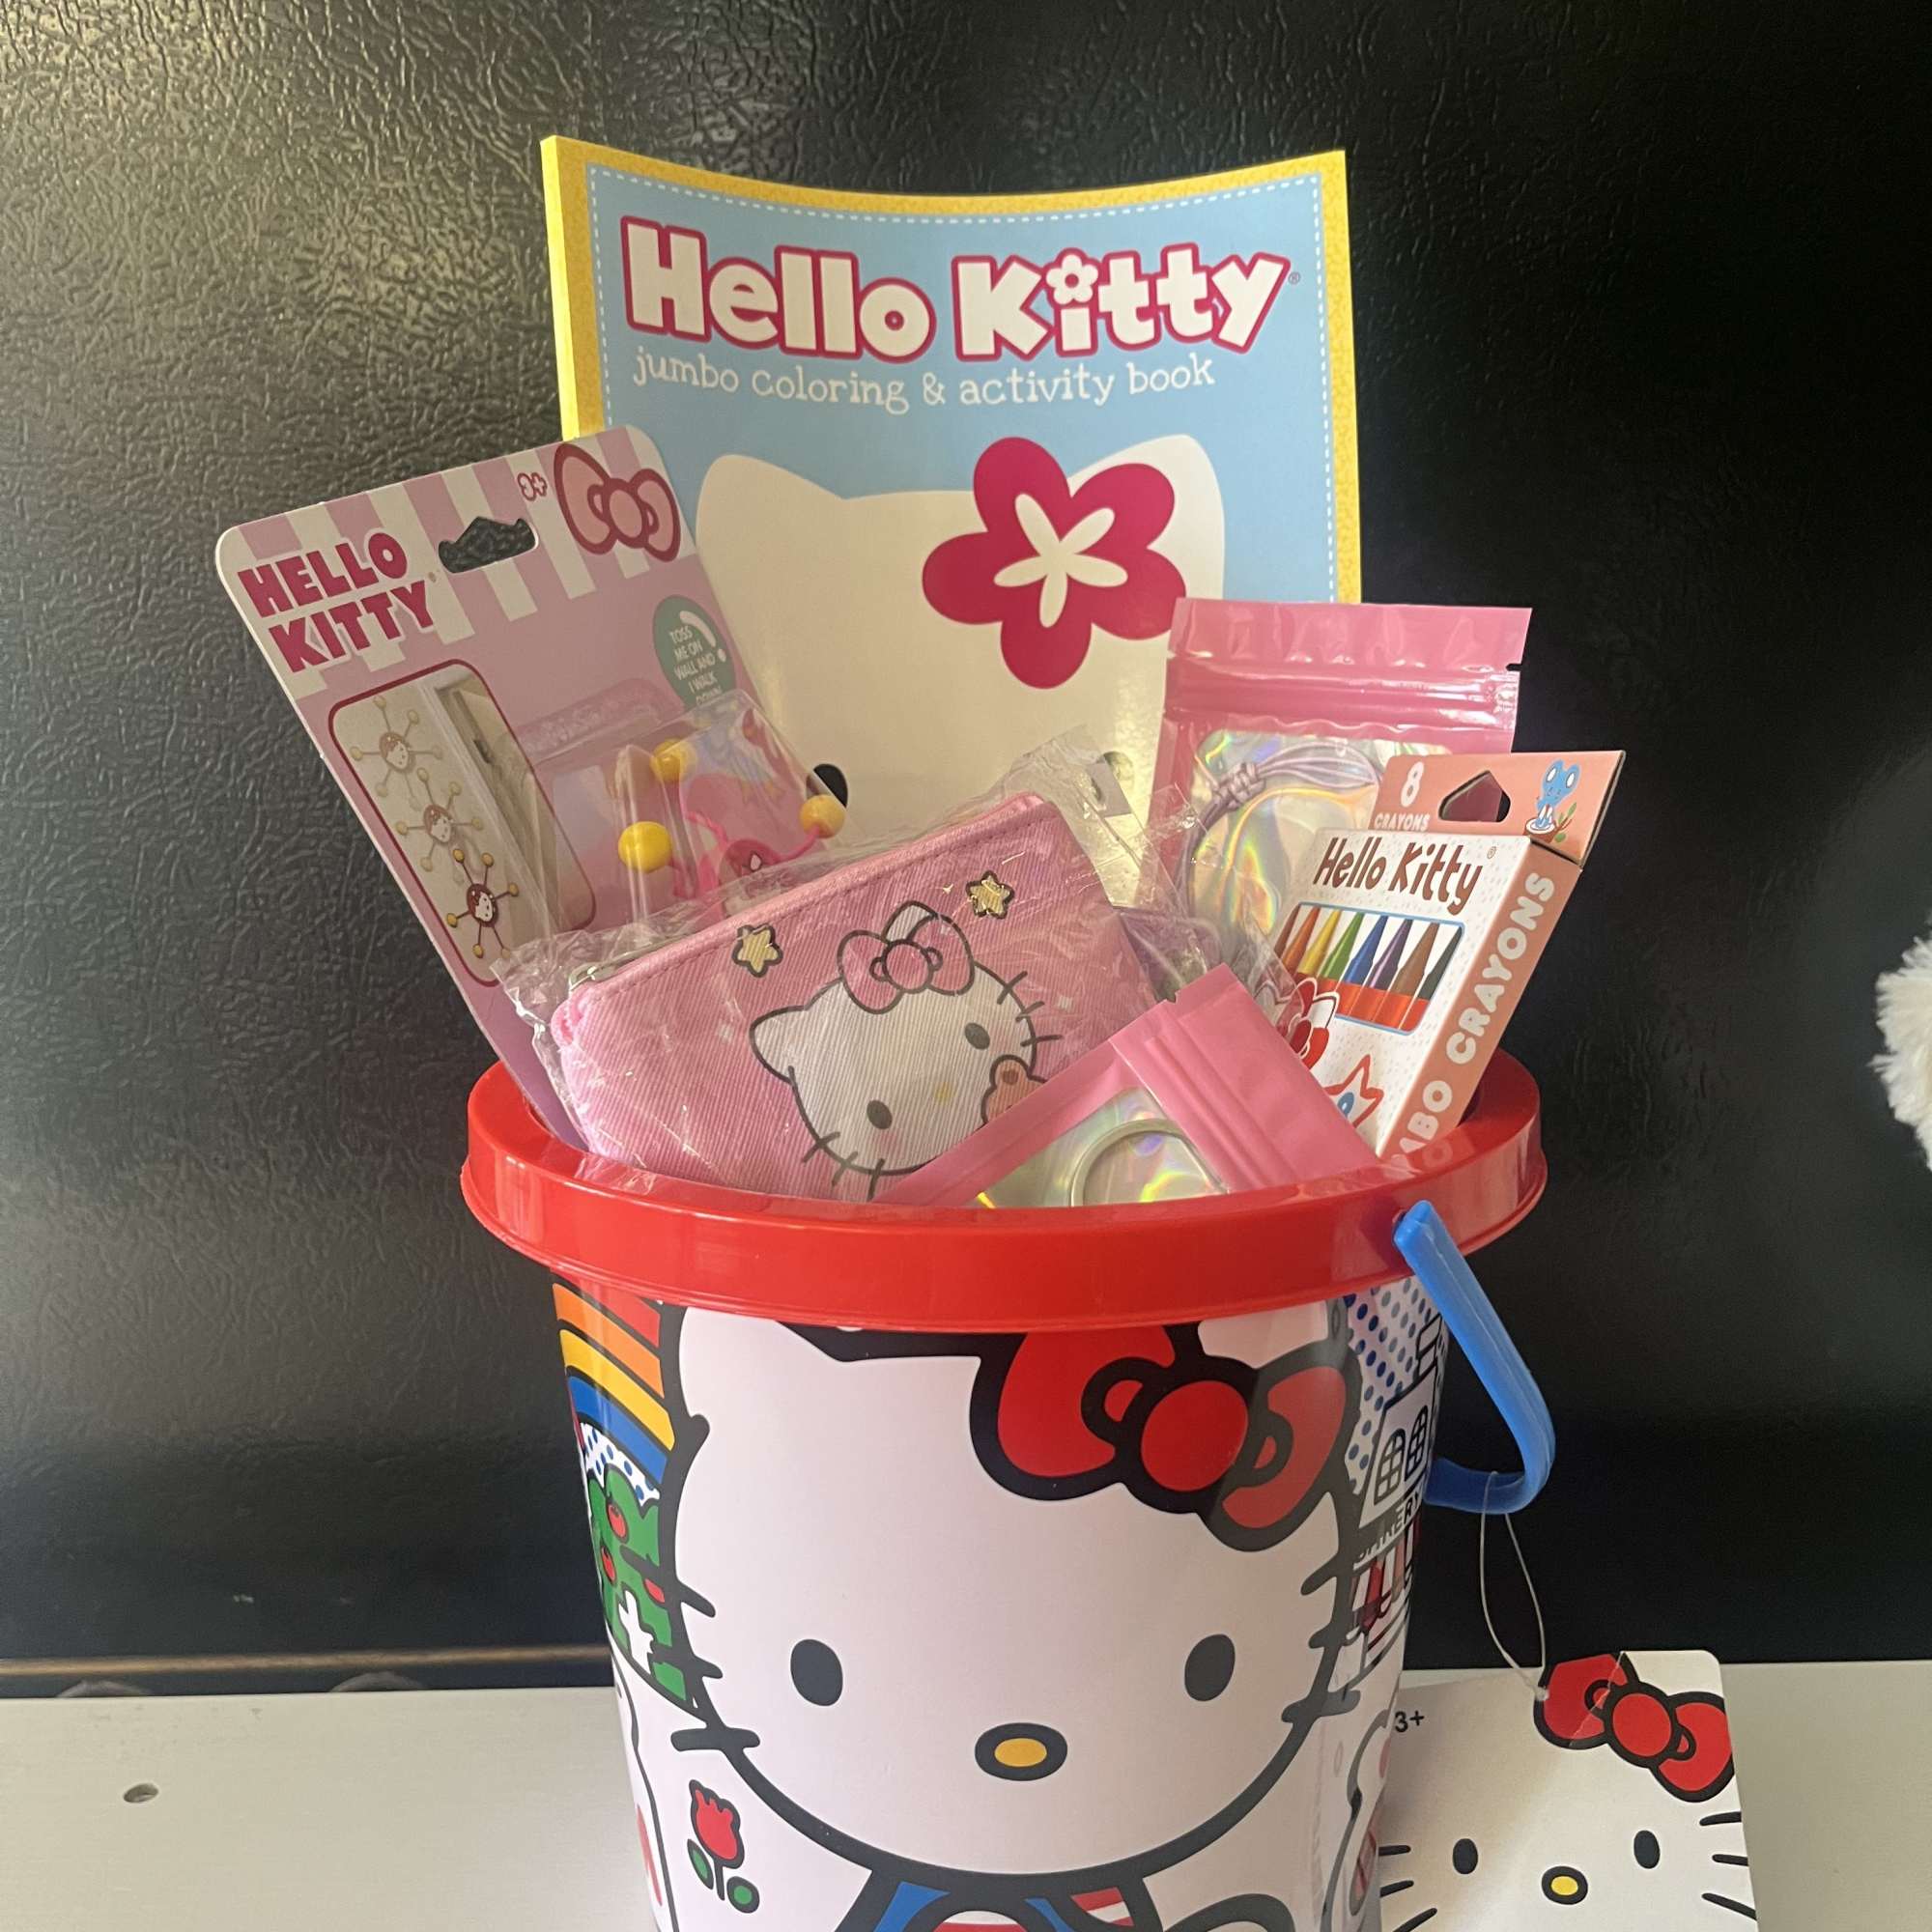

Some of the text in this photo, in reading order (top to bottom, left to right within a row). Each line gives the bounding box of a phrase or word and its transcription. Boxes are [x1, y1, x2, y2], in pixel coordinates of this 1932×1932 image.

[621, 215, 937, 363] Hello
[633, 346, 1215, 415] jumbo coloring & activity book
[238, 533, 408, 618] HELLO
[269, 580, 434, 672] KITTY
[1374, 812, 1431, 832] CRAYONS
[1401, 761, 1424, 808] 8
[1313, 837, 1484, 916] Hello Kitty
[1446, 872, 1554, 1065] CRAYONS
[1395, 1710, 1425, 1733] 3+
